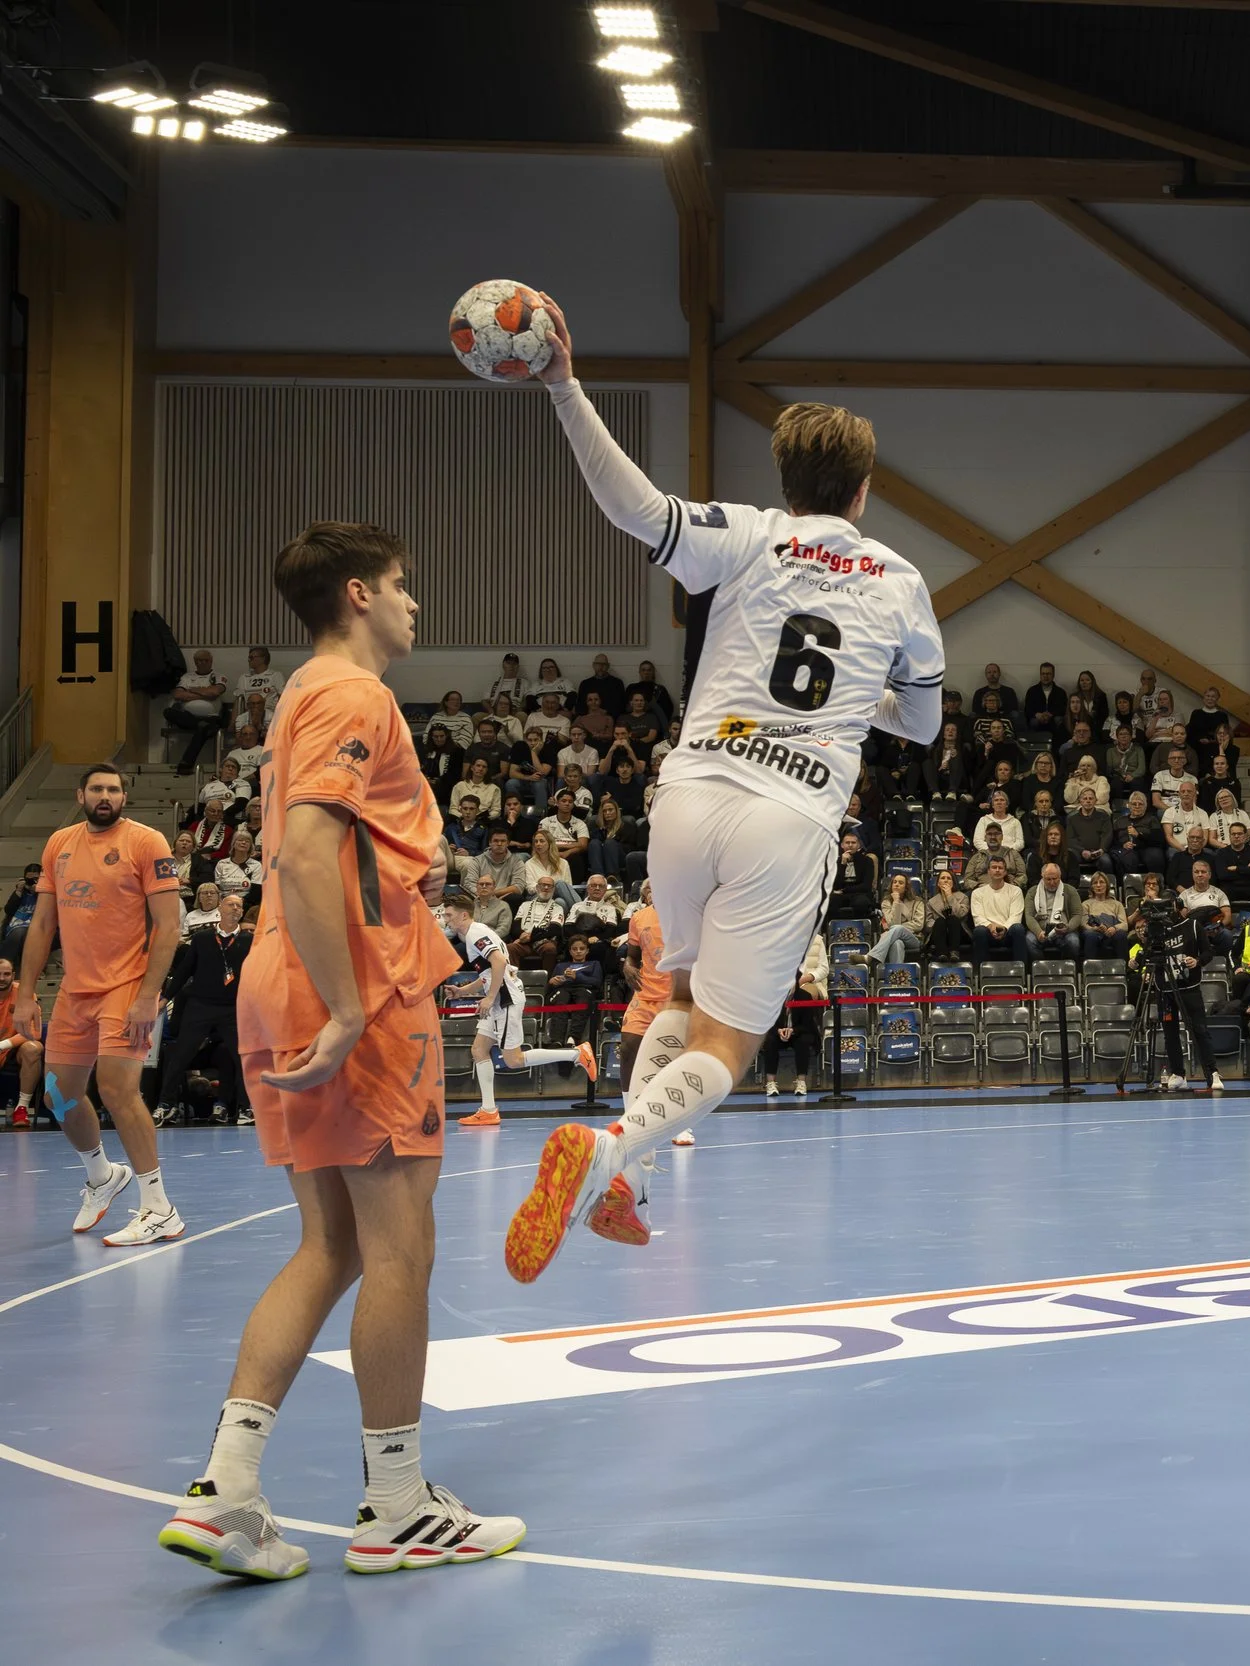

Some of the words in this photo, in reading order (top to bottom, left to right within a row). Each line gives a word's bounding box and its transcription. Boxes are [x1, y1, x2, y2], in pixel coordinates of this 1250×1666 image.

[785, 536, 854, 574] Anlegg
[859, 556, 885, 578] Øst
[61, 601, 113, 672] H
[769, 613, 841, 712] 6
[1164, 934, 1184, 948] EHF
